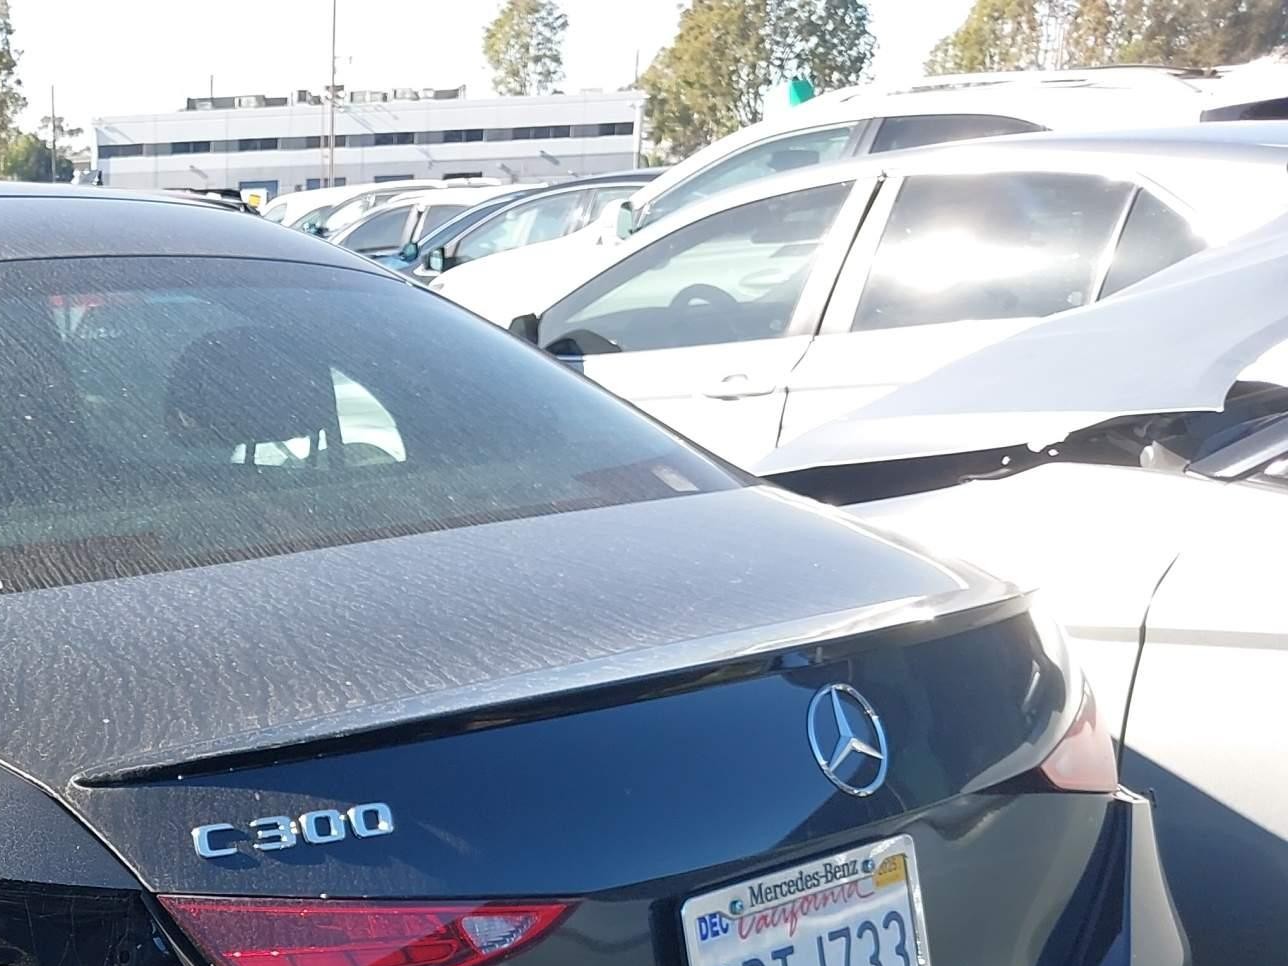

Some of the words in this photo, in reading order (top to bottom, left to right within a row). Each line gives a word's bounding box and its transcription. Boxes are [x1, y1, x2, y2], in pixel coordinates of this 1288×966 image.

[191, 822, 238, 859] C
[249, 802, 395, 851] 300
[748, 859, 859, 908] Mercedes-Benz
[697, 911, 730, 941] DEC
